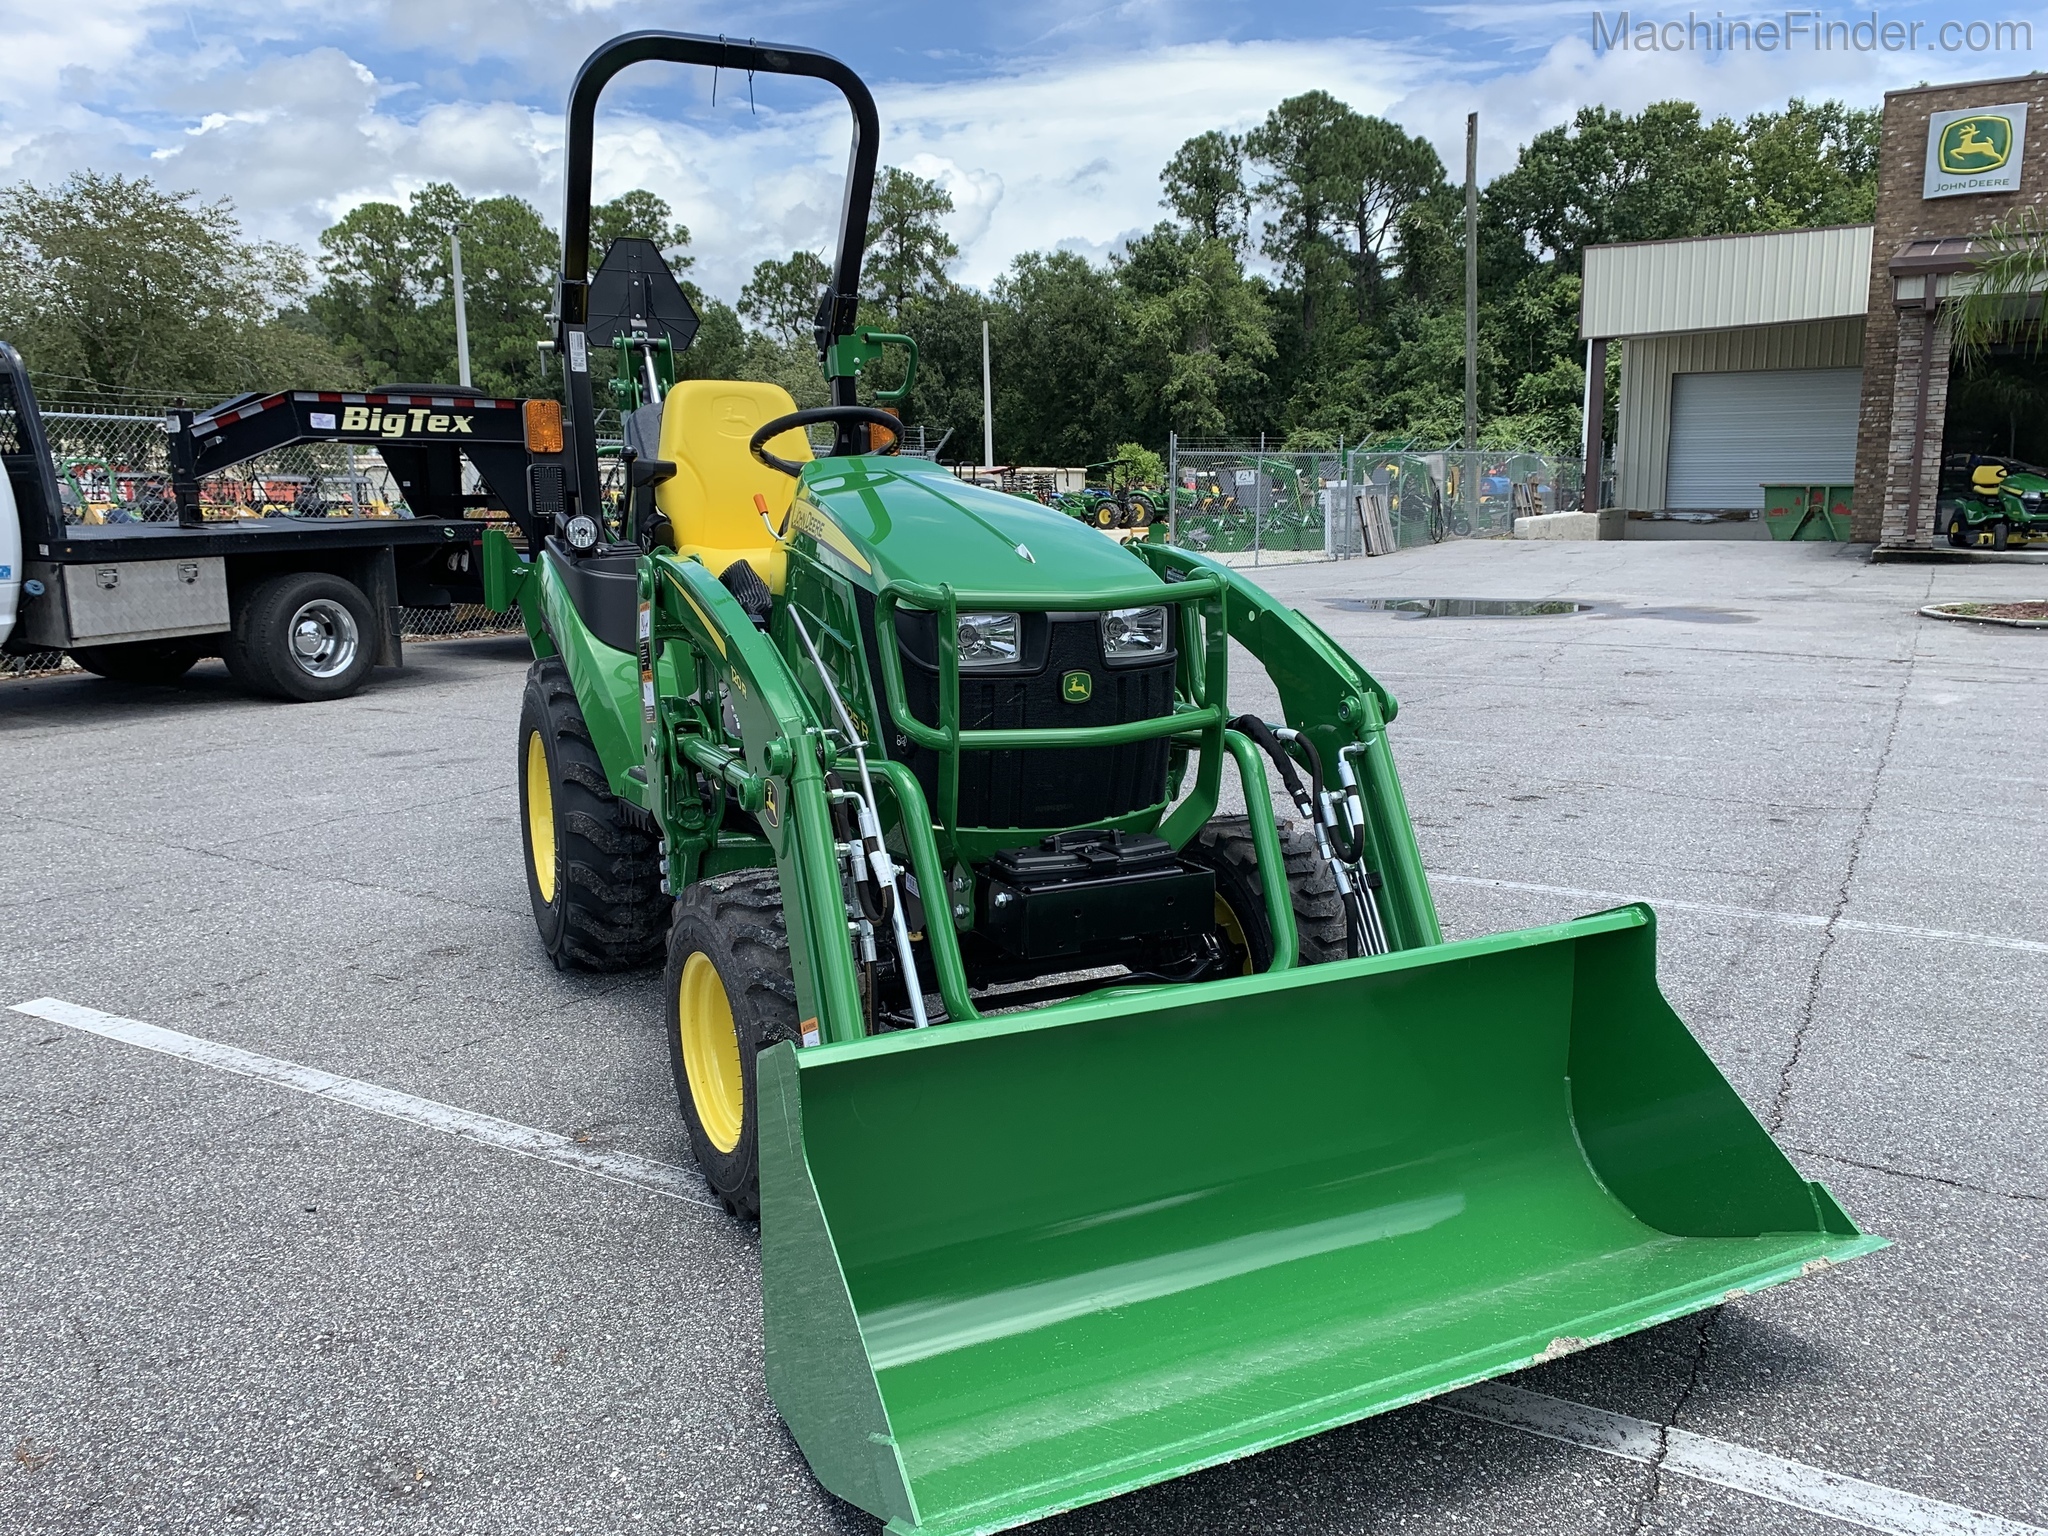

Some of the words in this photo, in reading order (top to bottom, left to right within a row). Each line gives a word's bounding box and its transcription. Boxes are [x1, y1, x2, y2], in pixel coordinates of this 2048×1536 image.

[1934, 182, 1967, 193] JOHN
[1968, 178, 2010, 188] DEERE
[341, 406, 474, 437] BigTex
[805, 511, 825, 538] DEERE
